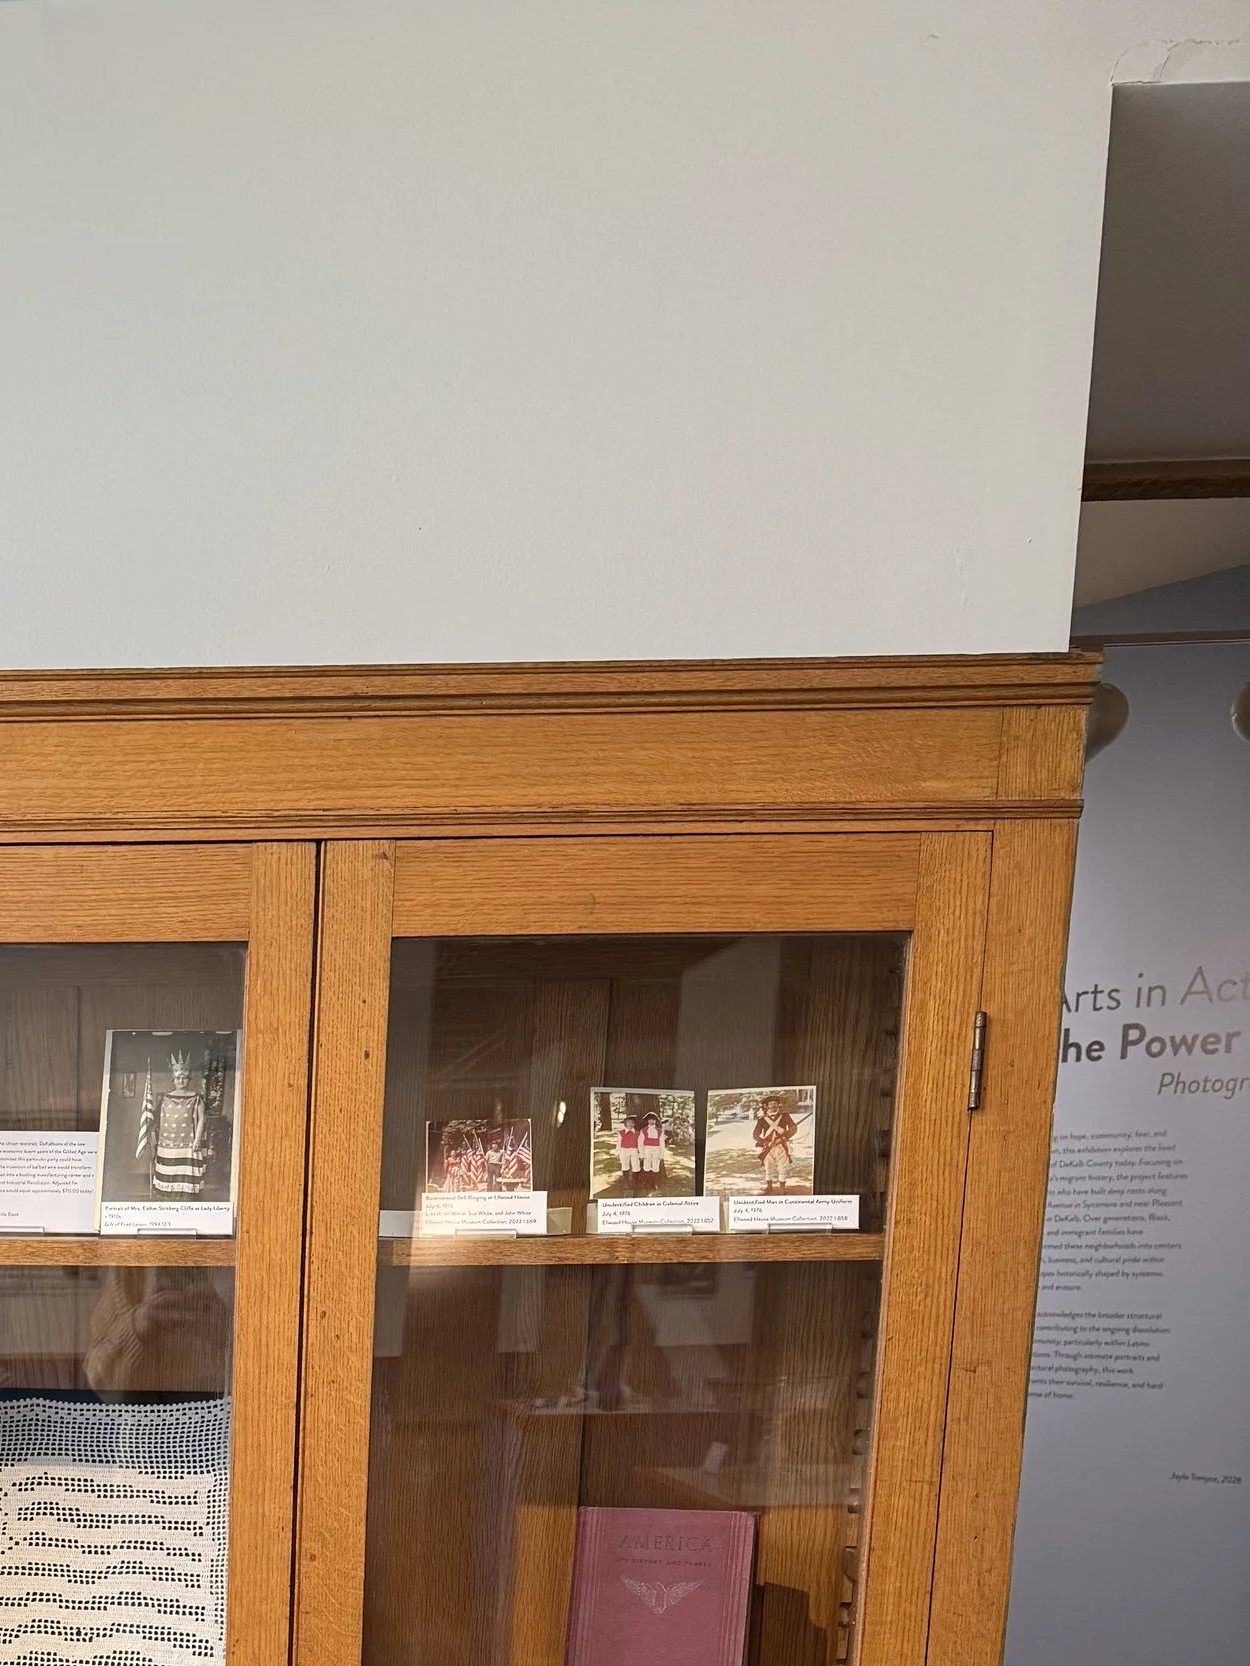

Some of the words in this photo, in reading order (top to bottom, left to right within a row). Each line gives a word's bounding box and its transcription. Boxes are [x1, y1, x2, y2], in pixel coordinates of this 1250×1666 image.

[1136, 973, 1167, 1009] in
[1120, 1023, 1241, 1059] Power
[1086, 1158, 1114, 1170] County
[619, 1535, 713, 1552] AMERICA
